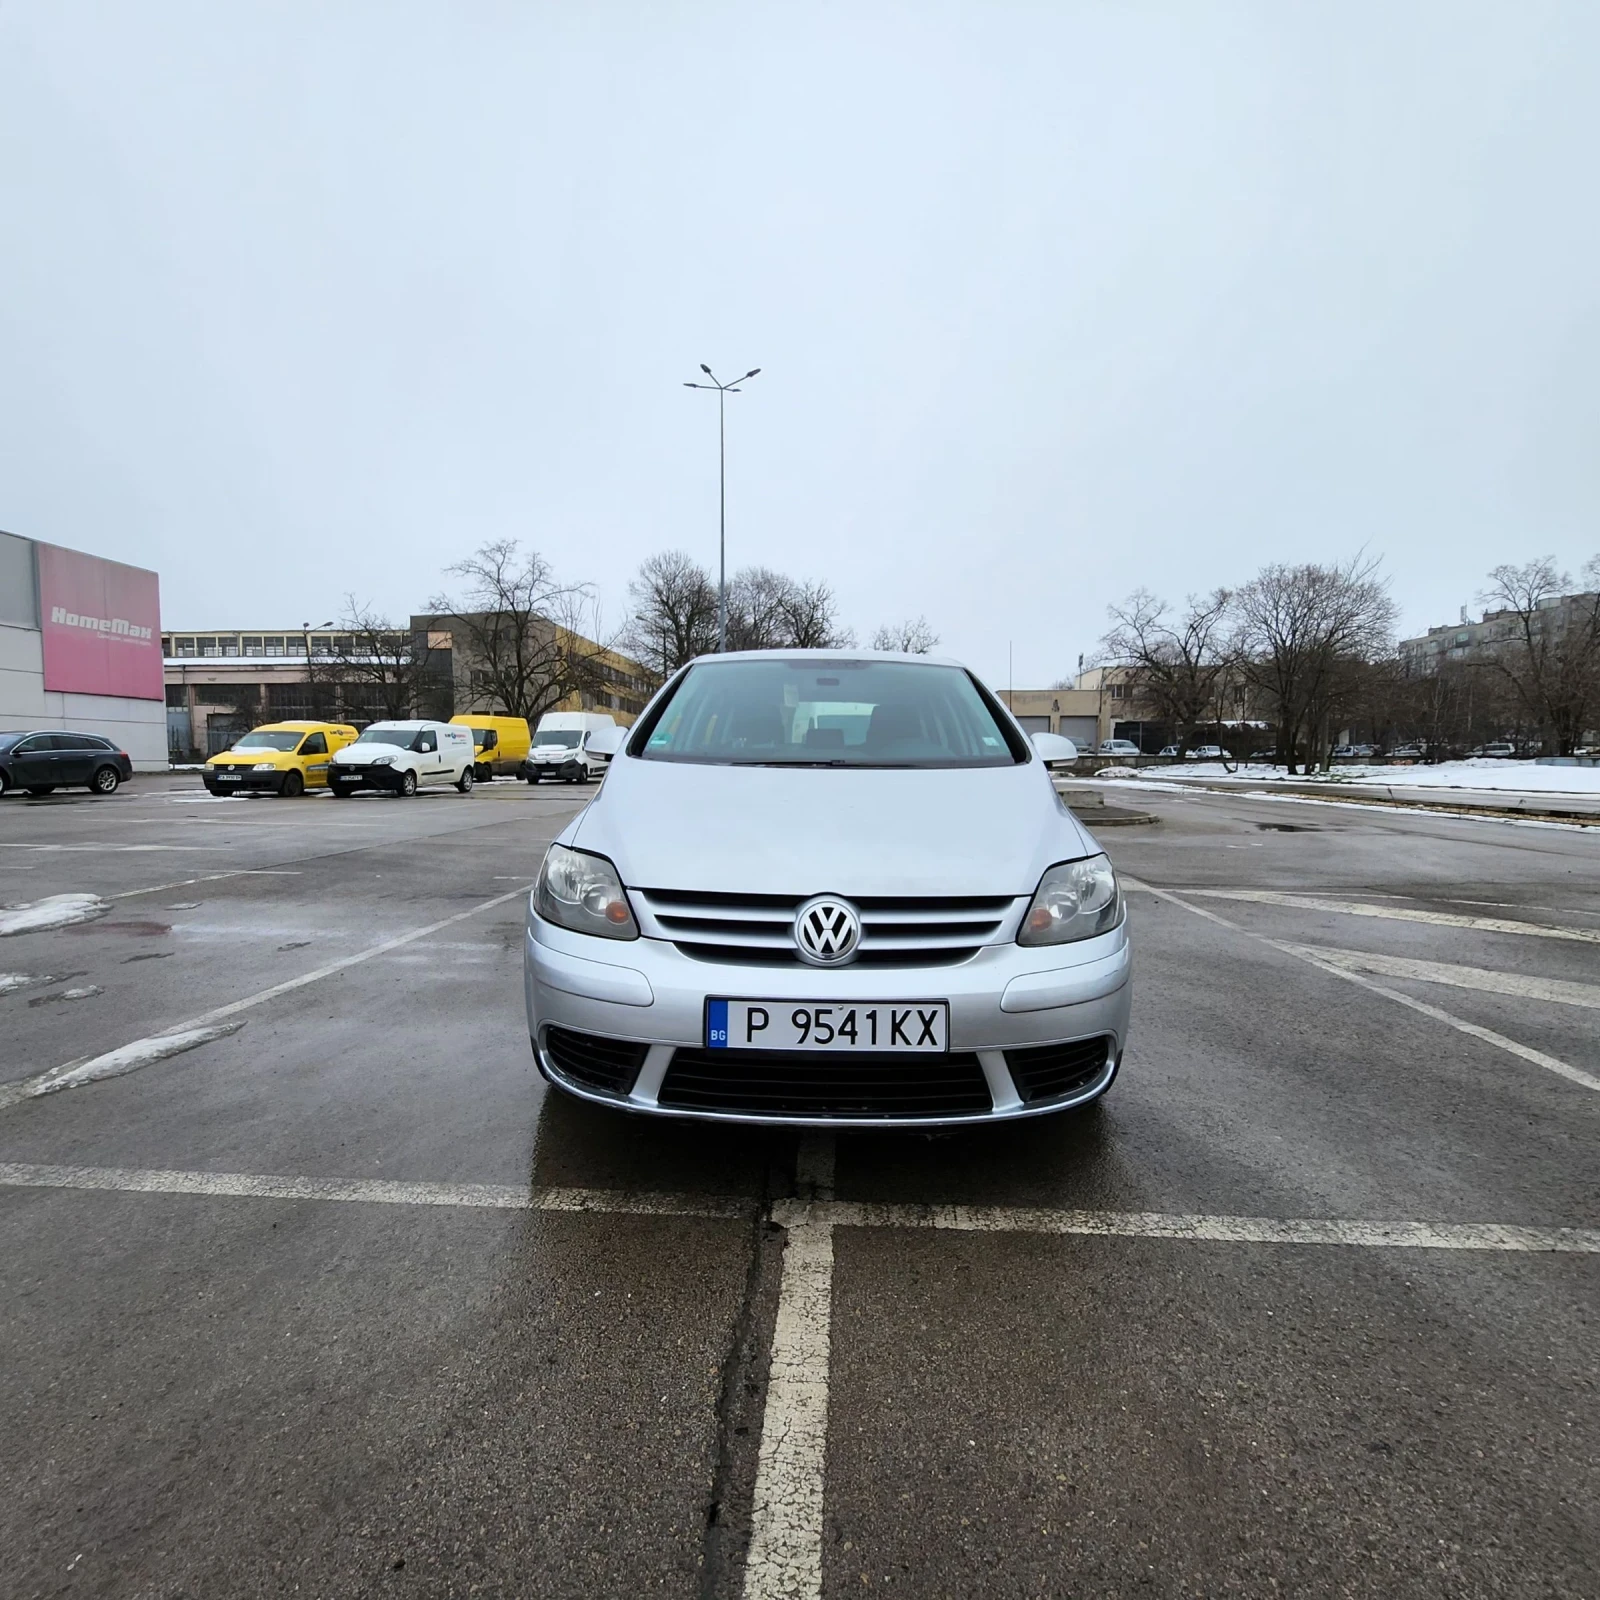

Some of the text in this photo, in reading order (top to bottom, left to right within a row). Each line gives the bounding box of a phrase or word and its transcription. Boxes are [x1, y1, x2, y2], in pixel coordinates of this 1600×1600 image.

[51, 606, 152, 639] HomeMax
[710, 1029, 727, 1041] BG
[746, 1007, 770, 1043] P
